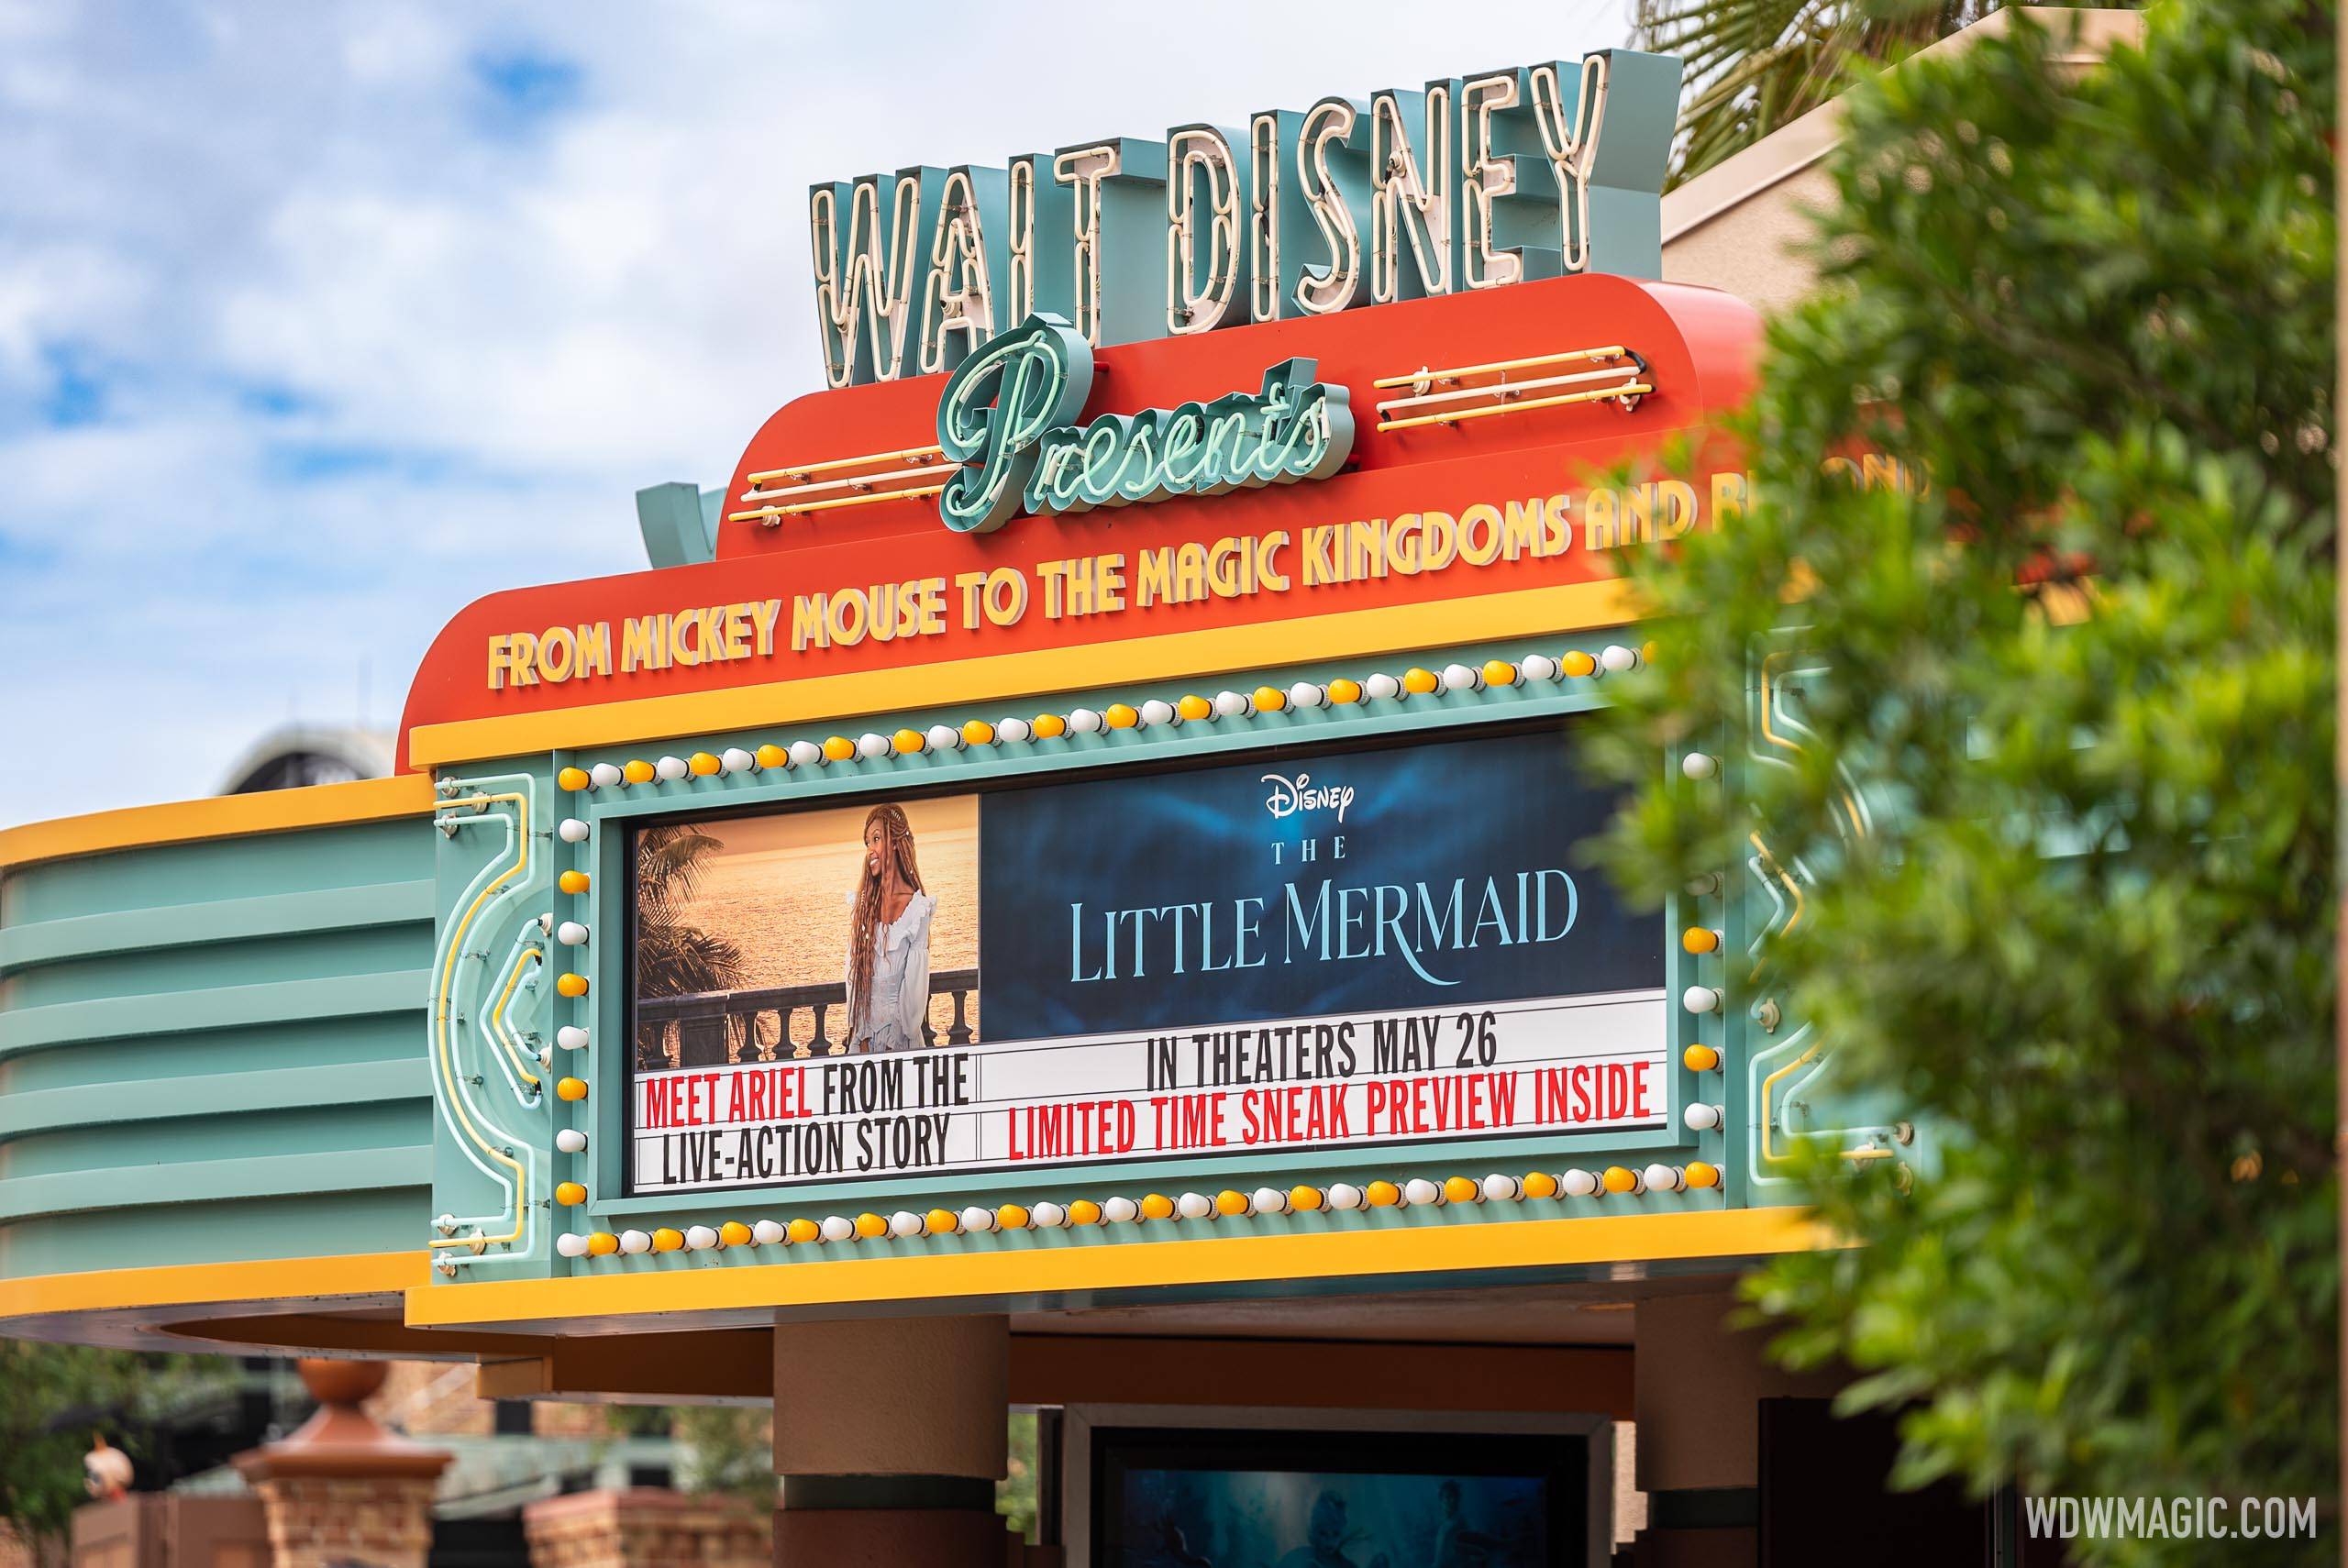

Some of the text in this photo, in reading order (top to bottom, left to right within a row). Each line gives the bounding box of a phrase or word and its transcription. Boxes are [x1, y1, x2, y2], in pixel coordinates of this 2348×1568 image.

[810, 51, 1611, 389] WALT DISNEY
[937, 314, 1348, 532] Presents
[487, 620, 613, 689] FROM
[621, 599, 781, 672] MICKEY
[792, 577, 947, 650] MOUSE
[955, 567, 1027, 629] TO
[1037, 553, 1125, 618] THE
[1136, 530, 1290, 608] MAGIC
[1301, 494, 1572, 586] KINGDOMS
[1585, 479, 1698, 550] AND
[1260, 772, 1355, 823] Disney
[1271, 835, 1346, 866] THE
[1070, 869, 1579, 986] LITTLE MERMAID
[646, 1053, 969, 1130] MEET ARIEL FROM THE
[1147, 1010, 1498, 1092] IN THEATERS MAY 26
[662, 1112, 951, 1185] LIVE-ACTION STORY
[1008, 1061, 1652, 1161] LIMITED TIME SNEAK PREVIEW INSIDE
